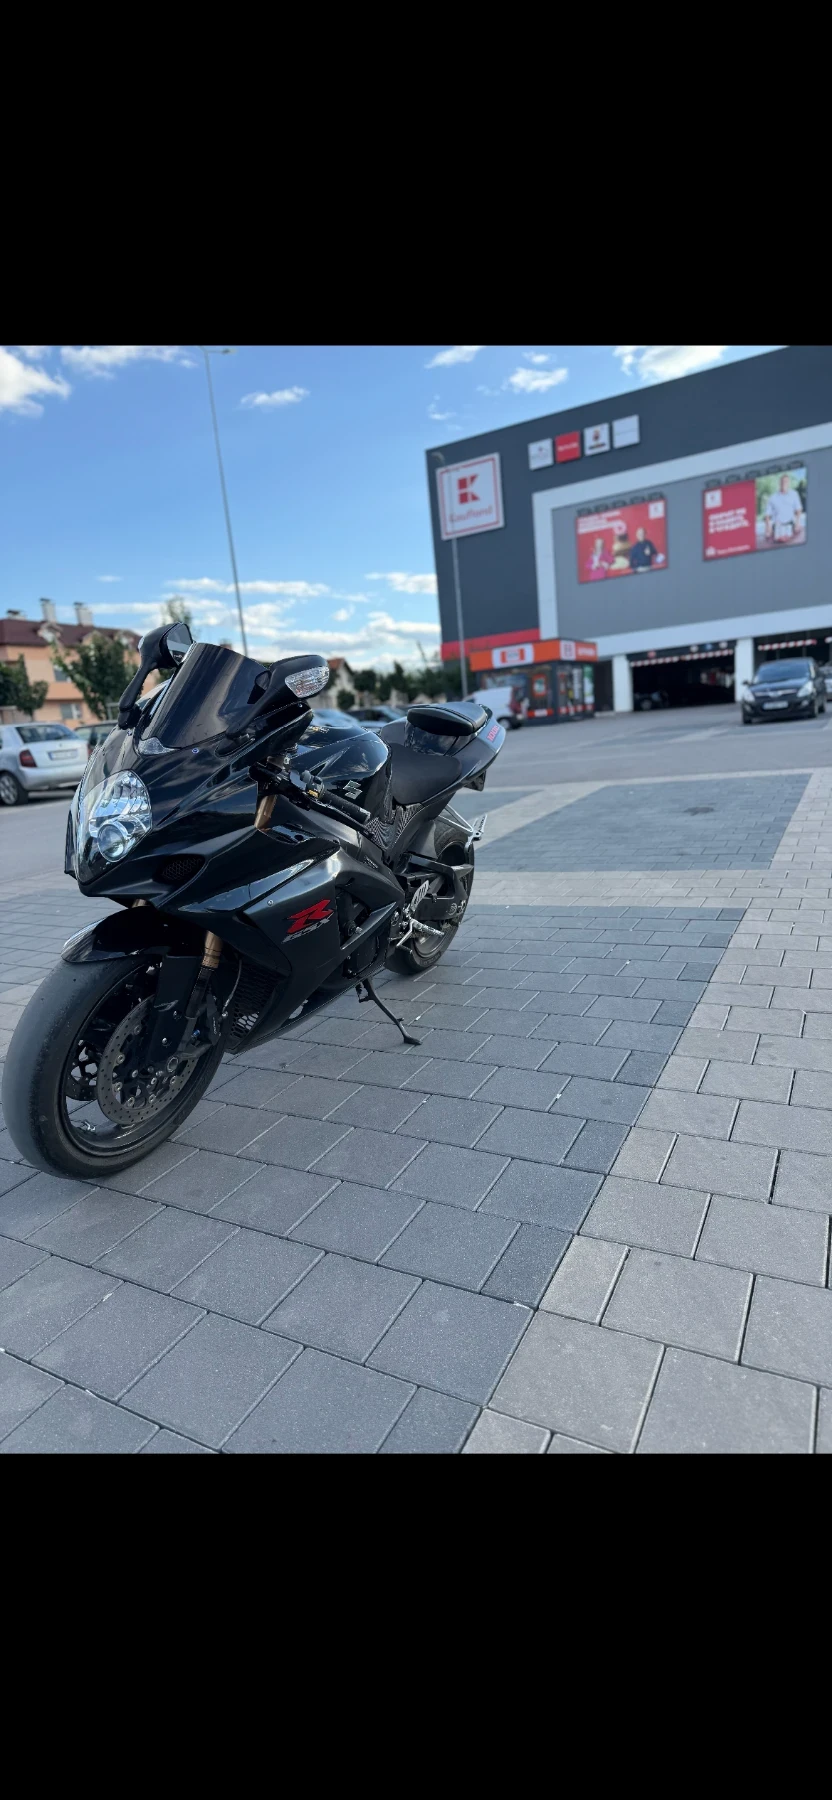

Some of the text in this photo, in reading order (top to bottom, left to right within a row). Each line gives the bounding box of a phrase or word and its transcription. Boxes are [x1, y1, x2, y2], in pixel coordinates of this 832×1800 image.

[457, 474, 480, 504] K
[450, 505, 493, 523] Kaufland
[287, 899, 334, 934] R
